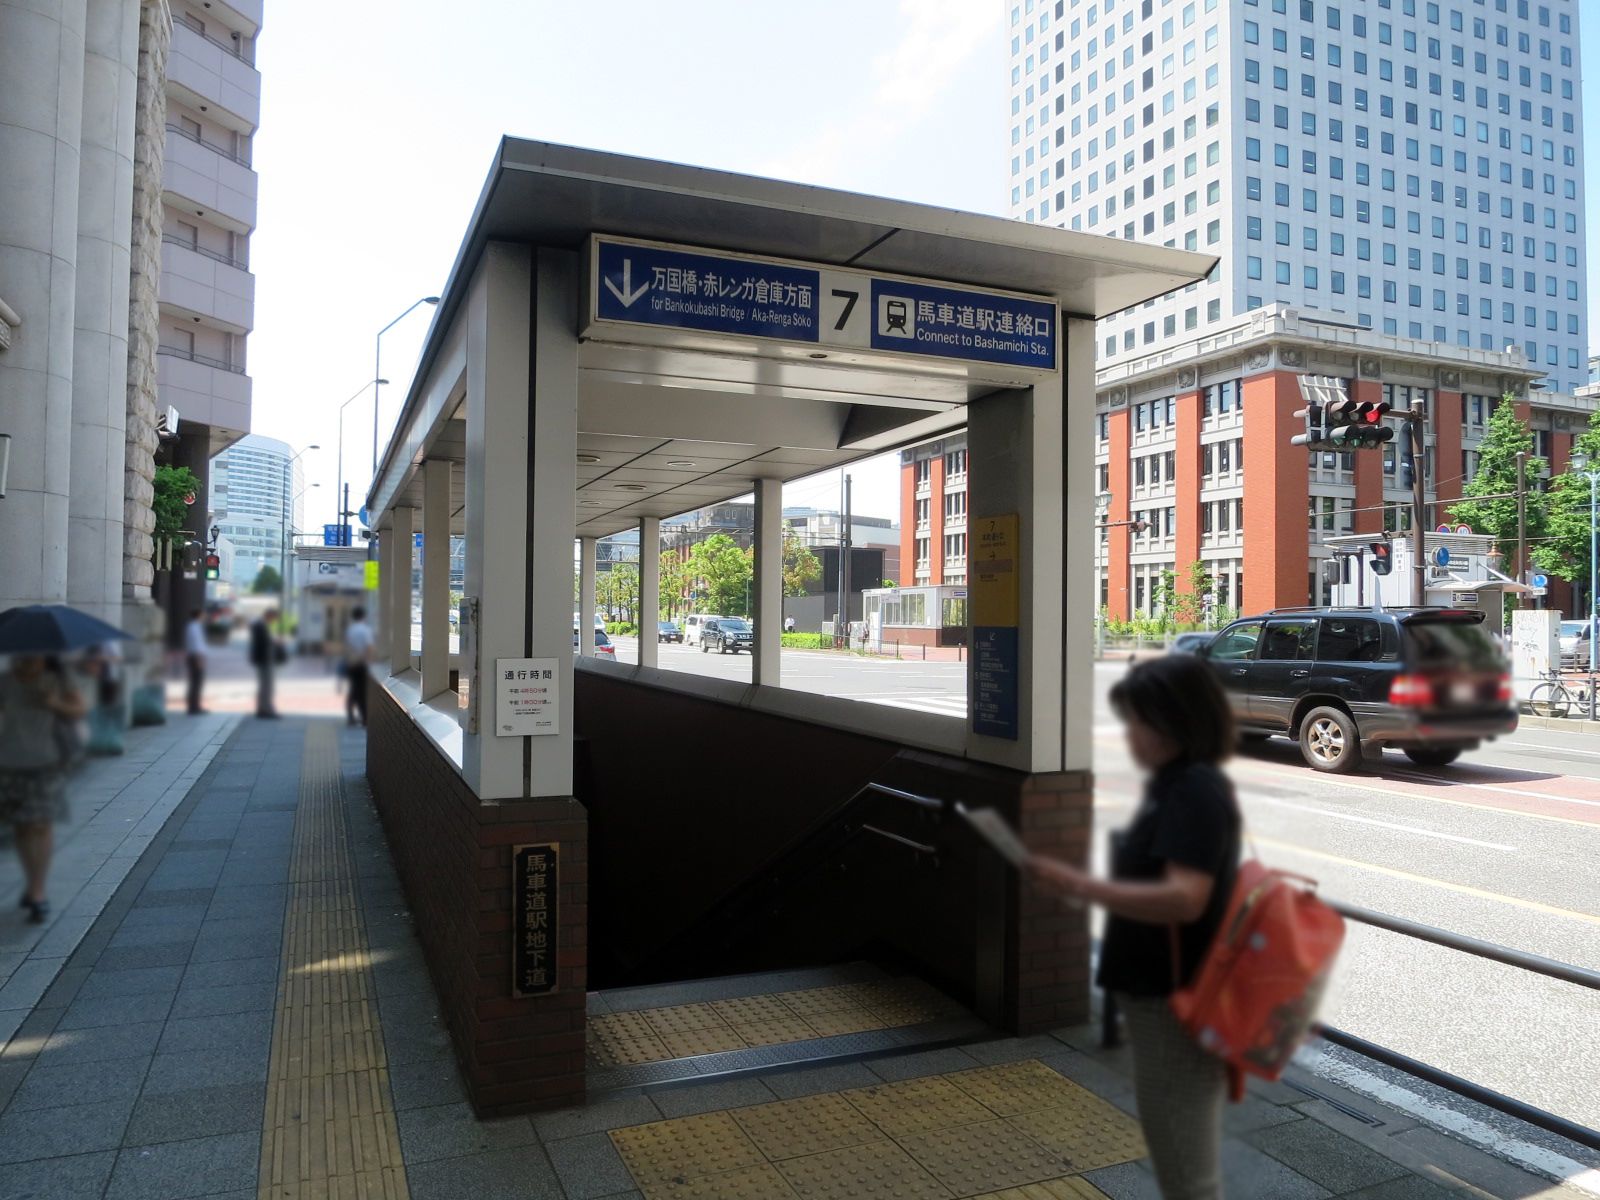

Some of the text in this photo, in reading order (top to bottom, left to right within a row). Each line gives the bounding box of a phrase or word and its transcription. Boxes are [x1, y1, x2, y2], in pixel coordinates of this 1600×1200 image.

[651, 296, 664, 310] for
[664, 299, 719, 318] Bankokubashi
[720, 304, 745, 322] Bridge
[751, 309, 792, 328] Aka-Renga
[792, 312, 812, 328] Soko
[831, 288, 860, 331] 7
[916, 300, 1050, 338] 馬車道駅連絡口
[916, 327, 1049, 356] Connect to Bashamichi Sta.
[505, 670, 552, 679] 通行時間
[526, 854, 547, 986] 馬車道駅地下道
